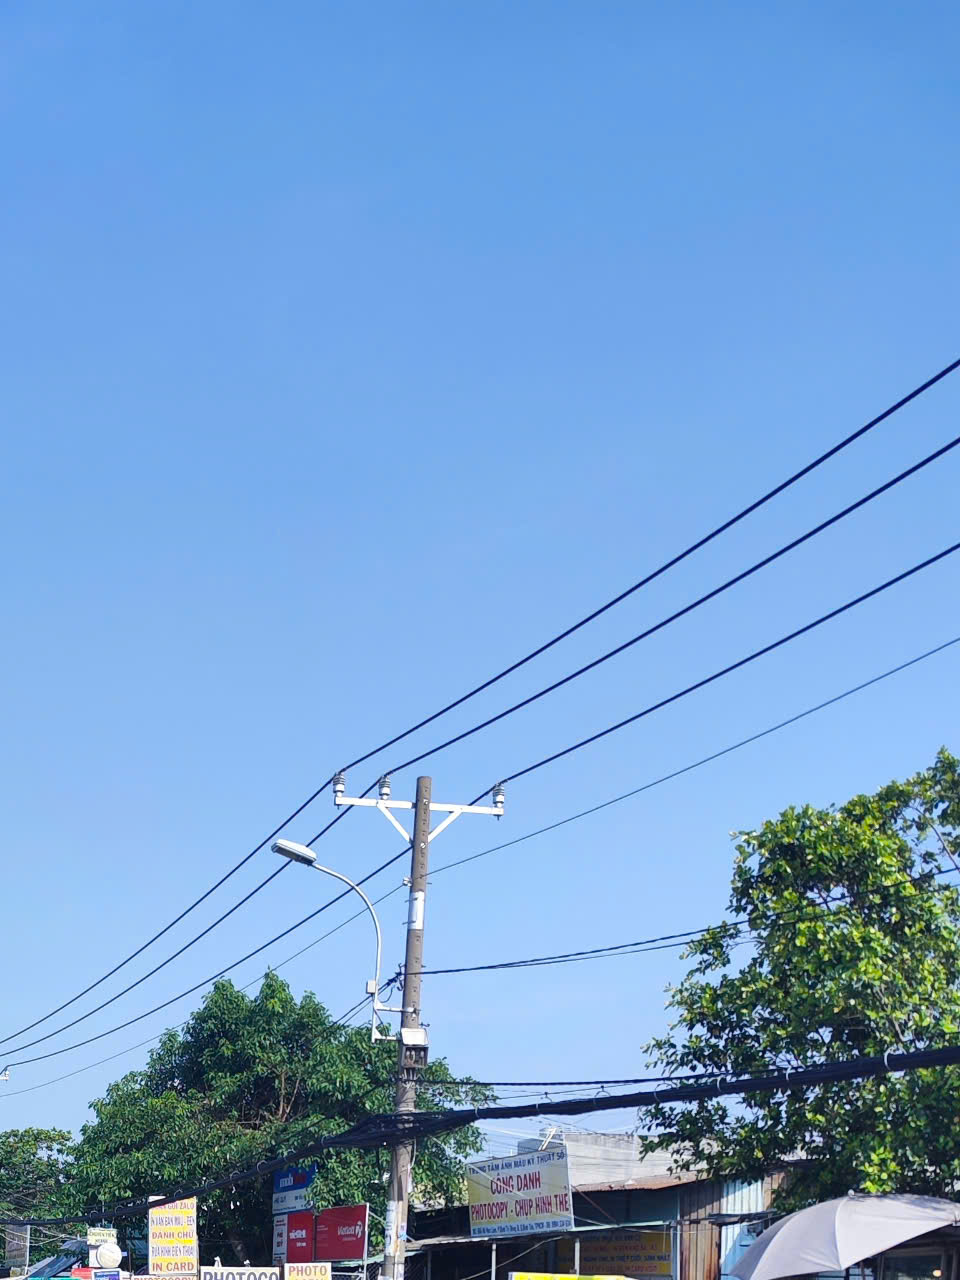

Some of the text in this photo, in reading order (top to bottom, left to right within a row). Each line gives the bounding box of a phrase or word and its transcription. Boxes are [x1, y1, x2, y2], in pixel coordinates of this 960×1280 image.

[490, 1171, 542, 1195] CÔNG DANH
[471, 1201, 508, 1221] PHOTOCOPY
[152, 1262, 194, 1272] IN CARD
[289, 1266, 327, 1276] PHOTO
